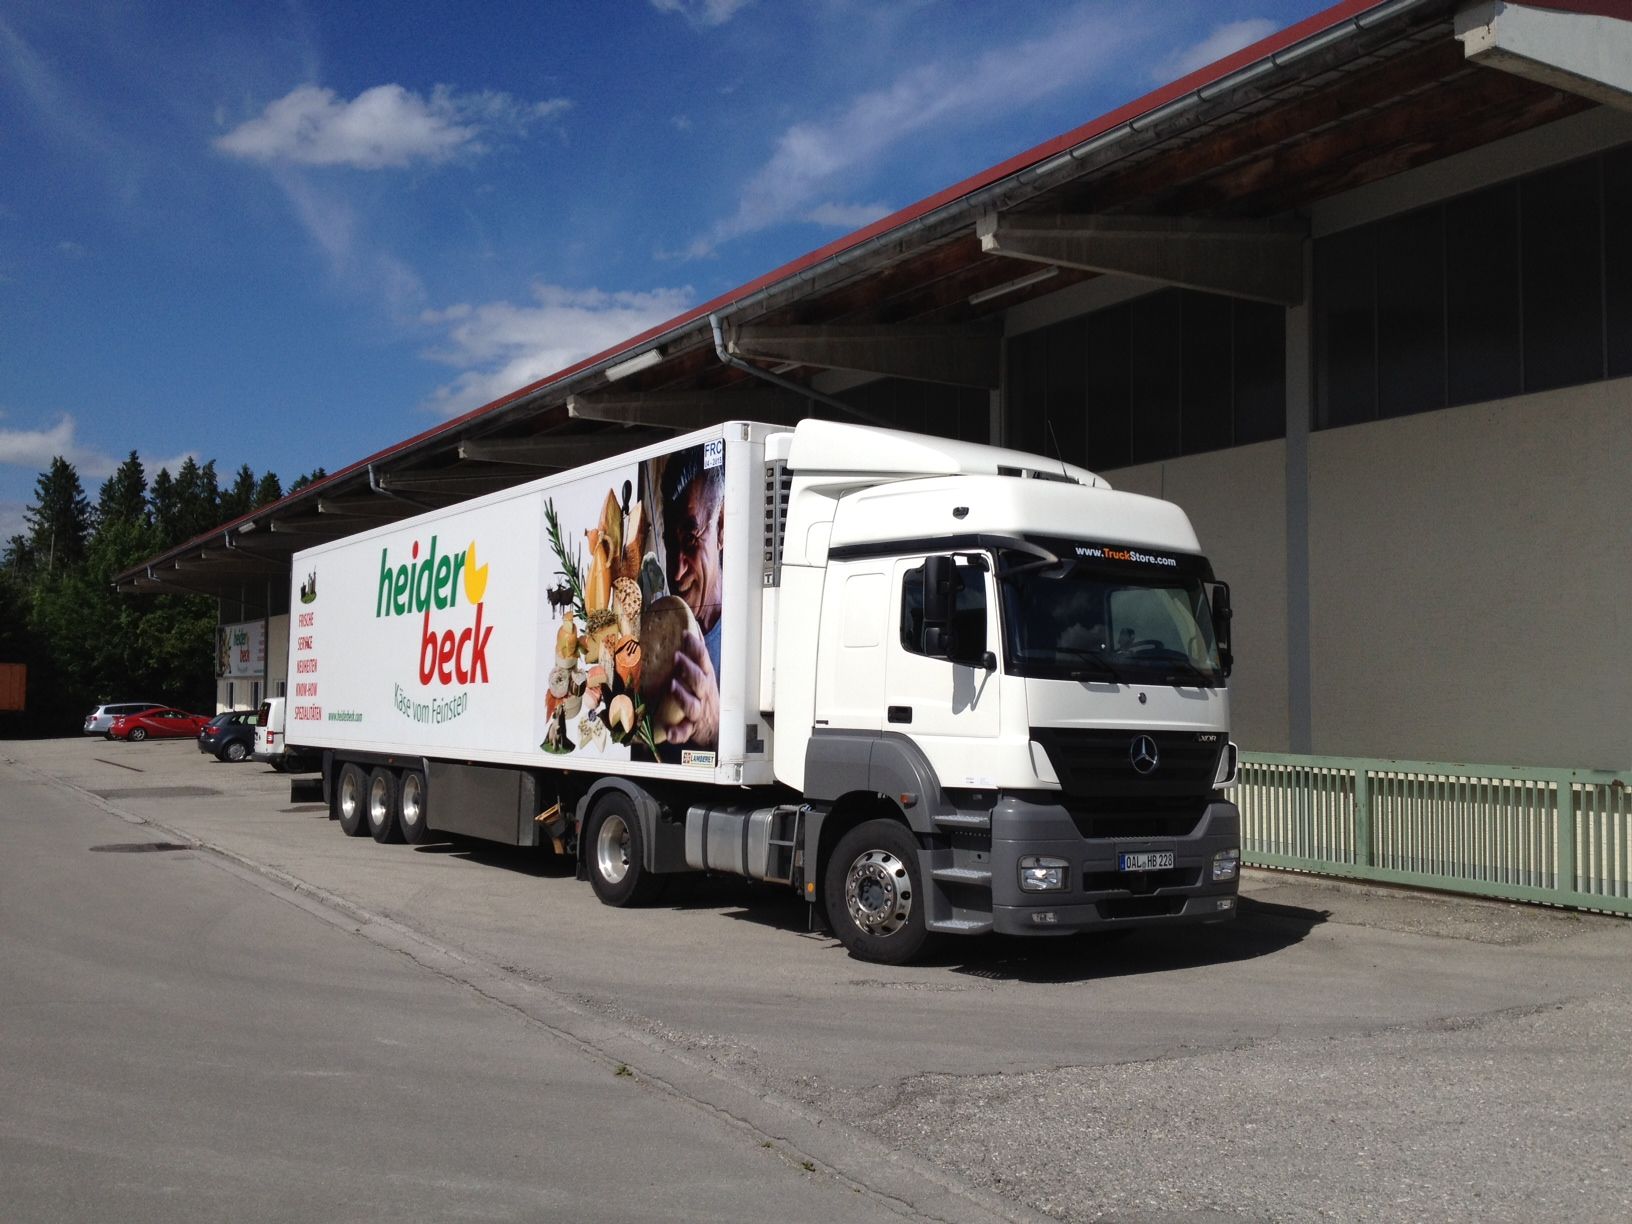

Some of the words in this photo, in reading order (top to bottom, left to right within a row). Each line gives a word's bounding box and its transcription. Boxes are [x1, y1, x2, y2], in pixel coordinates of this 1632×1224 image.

[705, 441, 722, 457] FRC
[1075, 546, 1177, 567] www.TruckStore.com
[376, 535, 467, 618] heider
[419, 602, 494, 686] beck
[394, 682, 411, 718] Käse
[412, 701, 430, 724] vom
[431, 691, 468, 725] Feinsten
[1126, 855, 1141, 869] OAL
[1147, 854, 1157, 868] HB
[1159, 853, 1173, 867] 228
